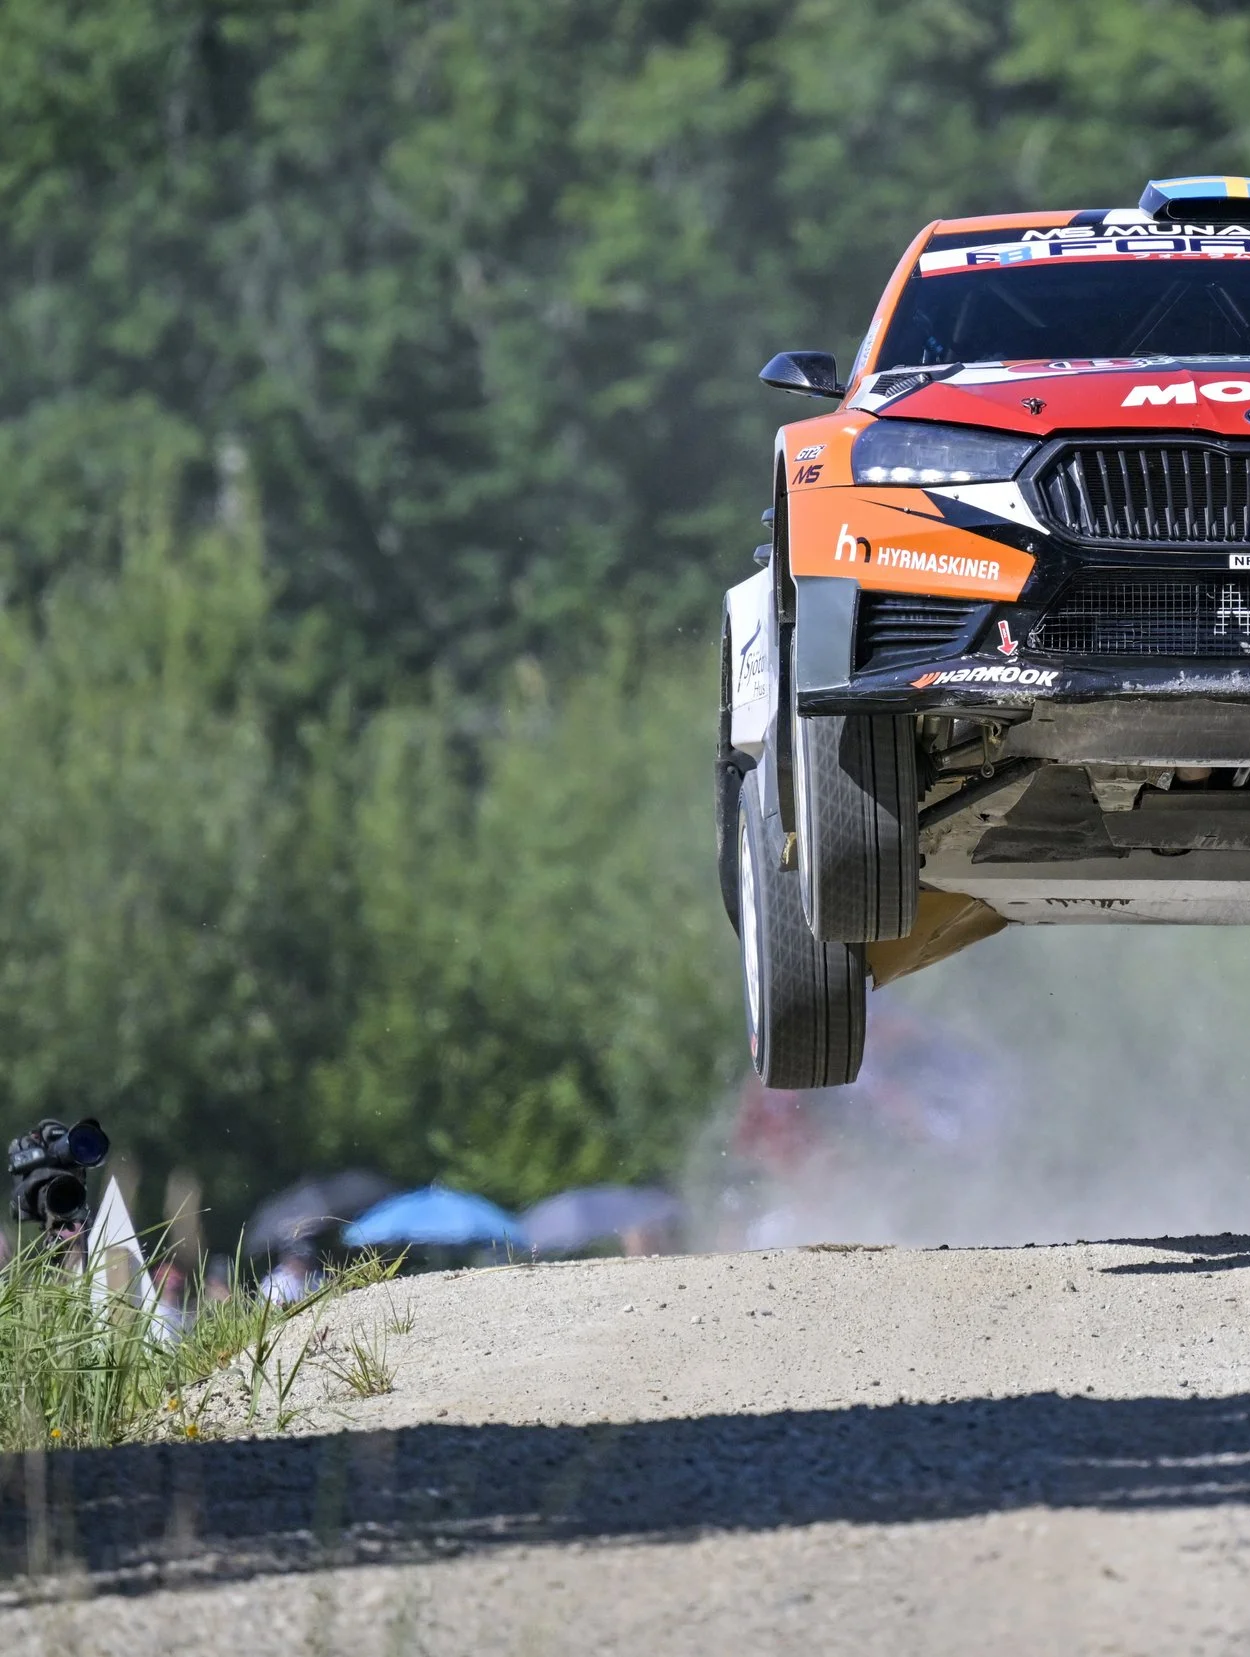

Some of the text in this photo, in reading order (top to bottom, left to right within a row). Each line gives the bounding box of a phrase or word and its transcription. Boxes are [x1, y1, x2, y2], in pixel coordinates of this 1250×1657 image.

[1021, 226, 1096, 241] MS
[792, 464, 824, 485] MS
[877, 546, 1000, 581] HYRMASKINER
